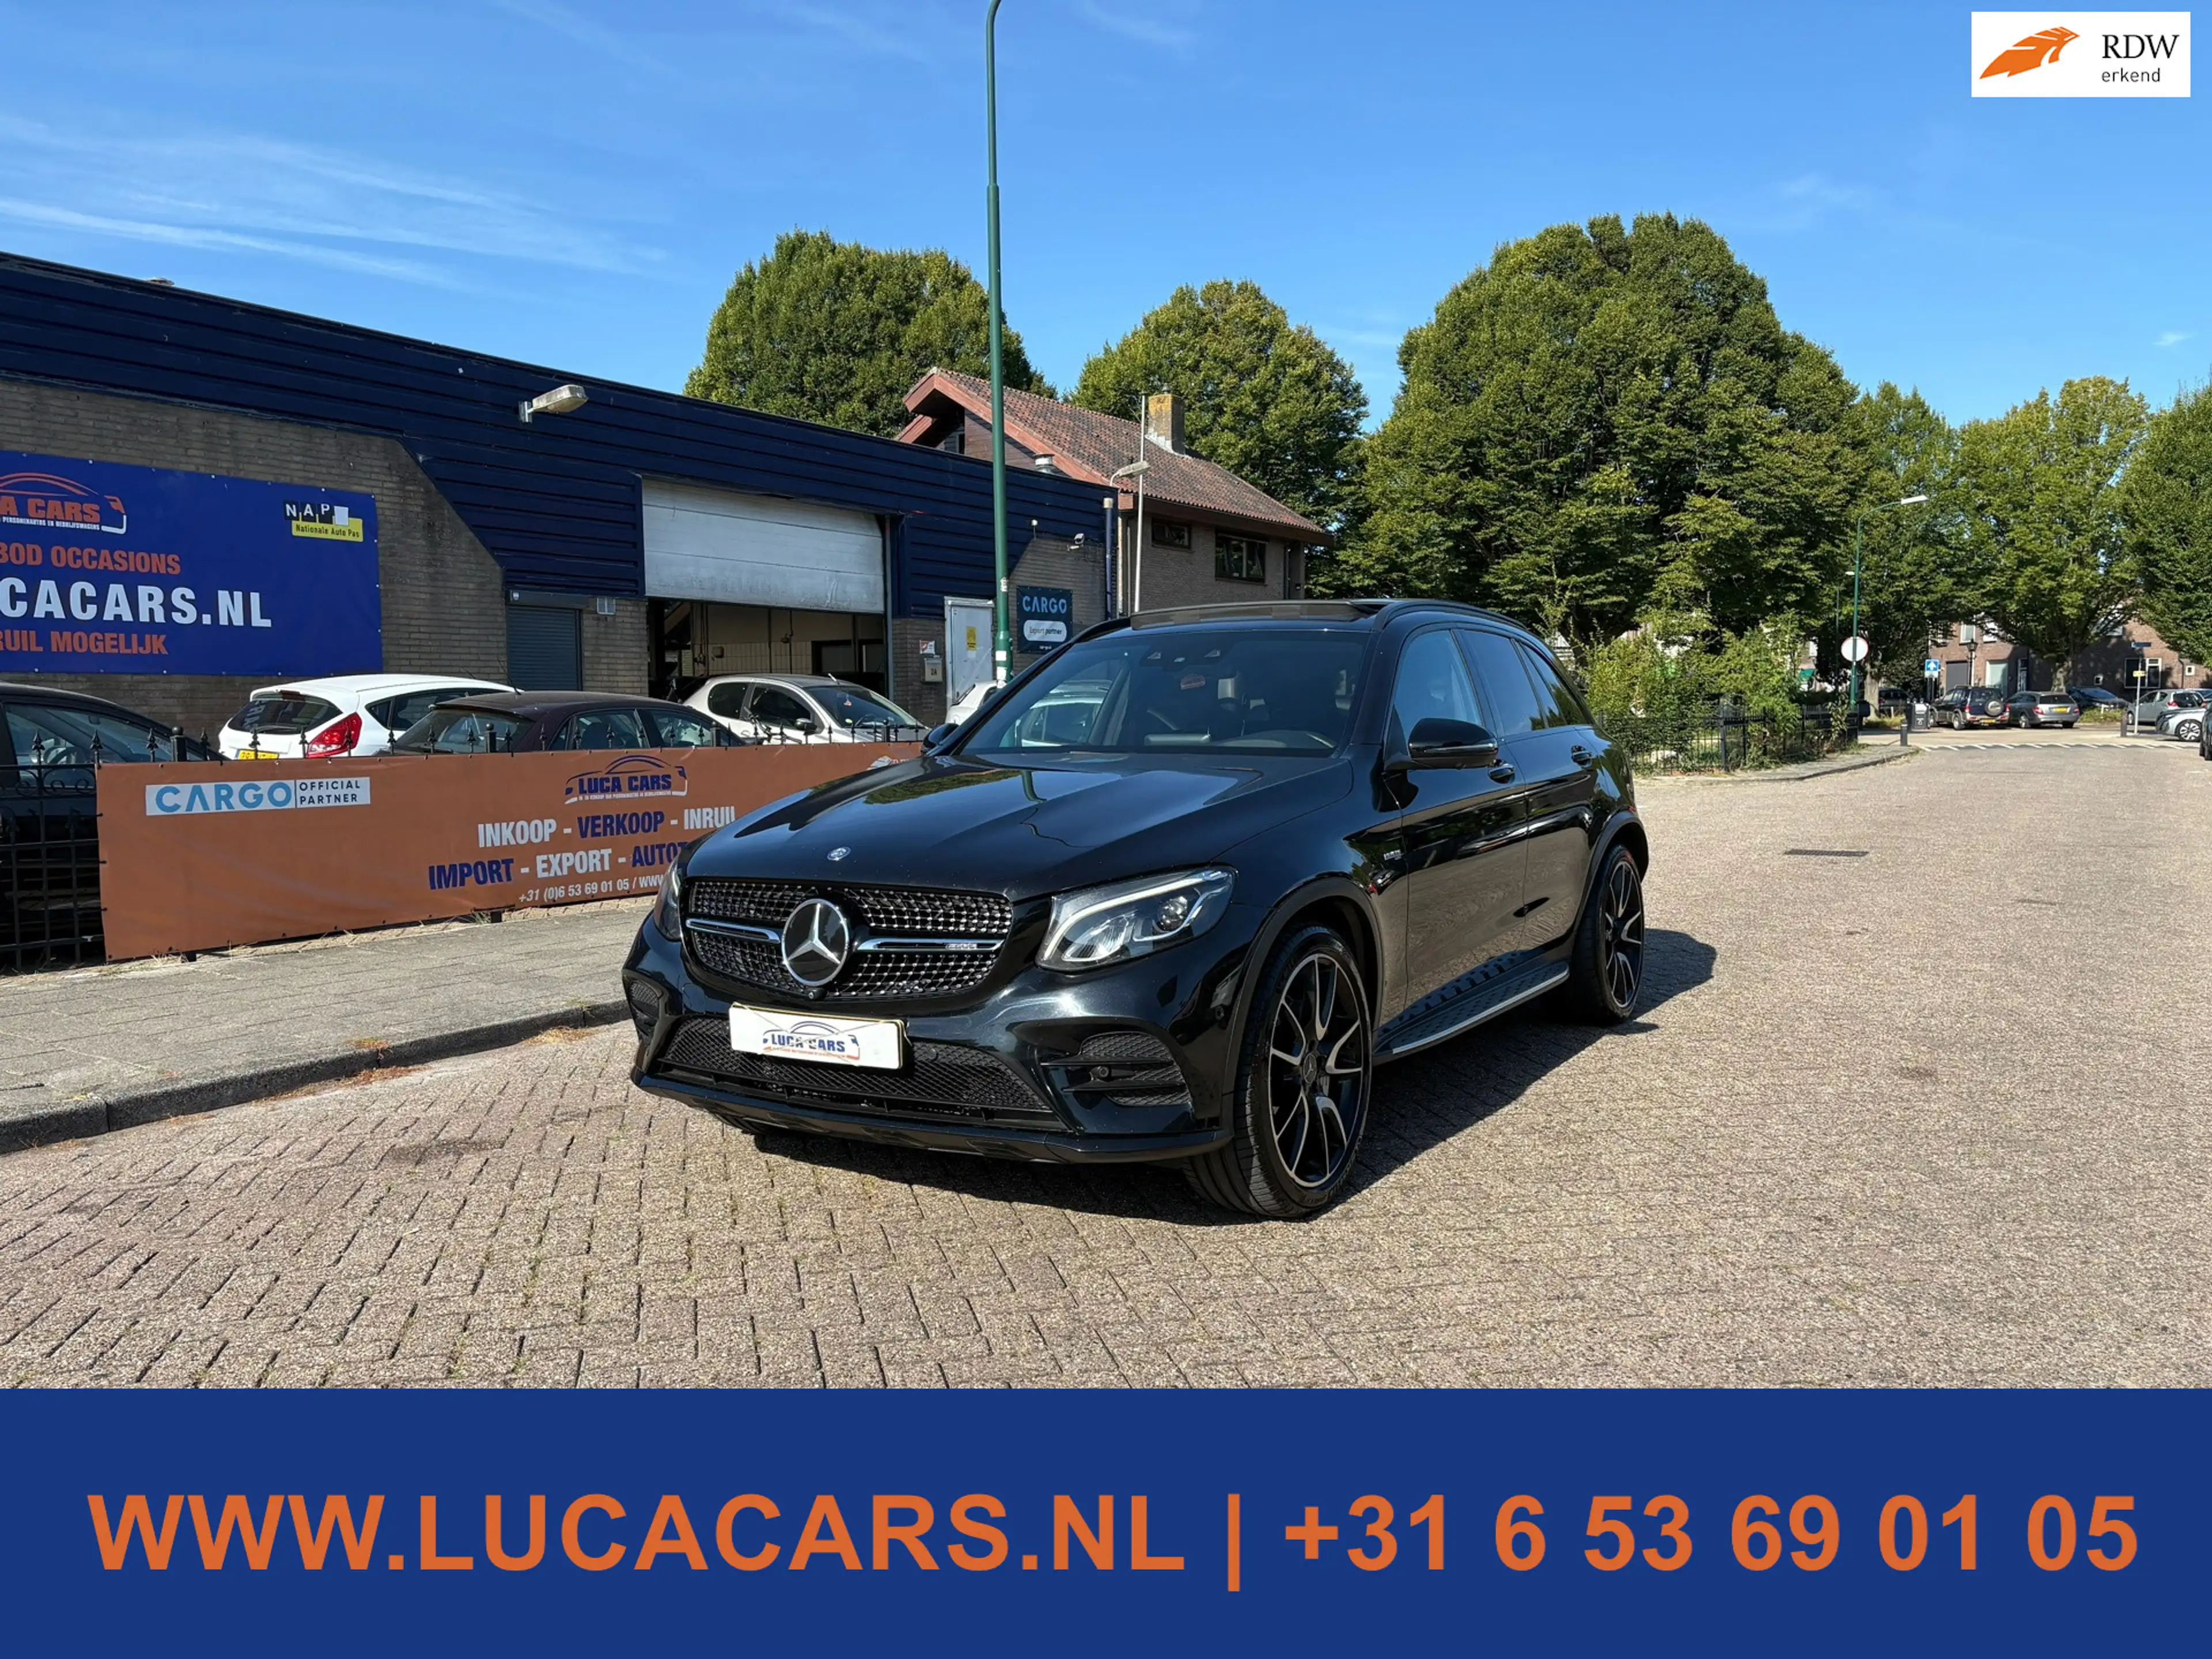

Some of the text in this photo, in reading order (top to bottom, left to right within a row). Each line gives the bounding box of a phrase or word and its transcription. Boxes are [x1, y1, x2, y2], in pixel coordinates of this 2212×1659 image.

[28, 499, 100, 522] CARS
[296, 524, 359, 537] Nationale Auto Pas
[51, 546, 180, 574] OCCASIONS
[0, 577, 271, 627] CACARS.NL
[1022, 596, 1067, 613] CARGO
[51, 631, 168, 654] MOGELIJK
[299, 780, 361, 791] OFFICIAL
[578, 774, 672, 794] LUCA CARS
[156, 782, 292, 813] CARGO
[300, 793, 358, 805] PARTNER
[478, 819, 557, 847] INKOOP
[577, 811, 665, 838] VERKOOP
[429, 858, 514, 890] IMPORT
[536, 849, 612, 878] EXPORT
[519, 889, 539, 903] +31
[544, 887, 565, 903] (0)6
[567, 884, 582, 897] 53
[585, 882, 598, 895] 69
[601, 880, 613, 893] 01
[616, 878, 629, 891] 05
[632, 877, 637, 889] /
[771, 1033, 804, 1048] LUCA
[809, 1037, 845, 1052] CARS
